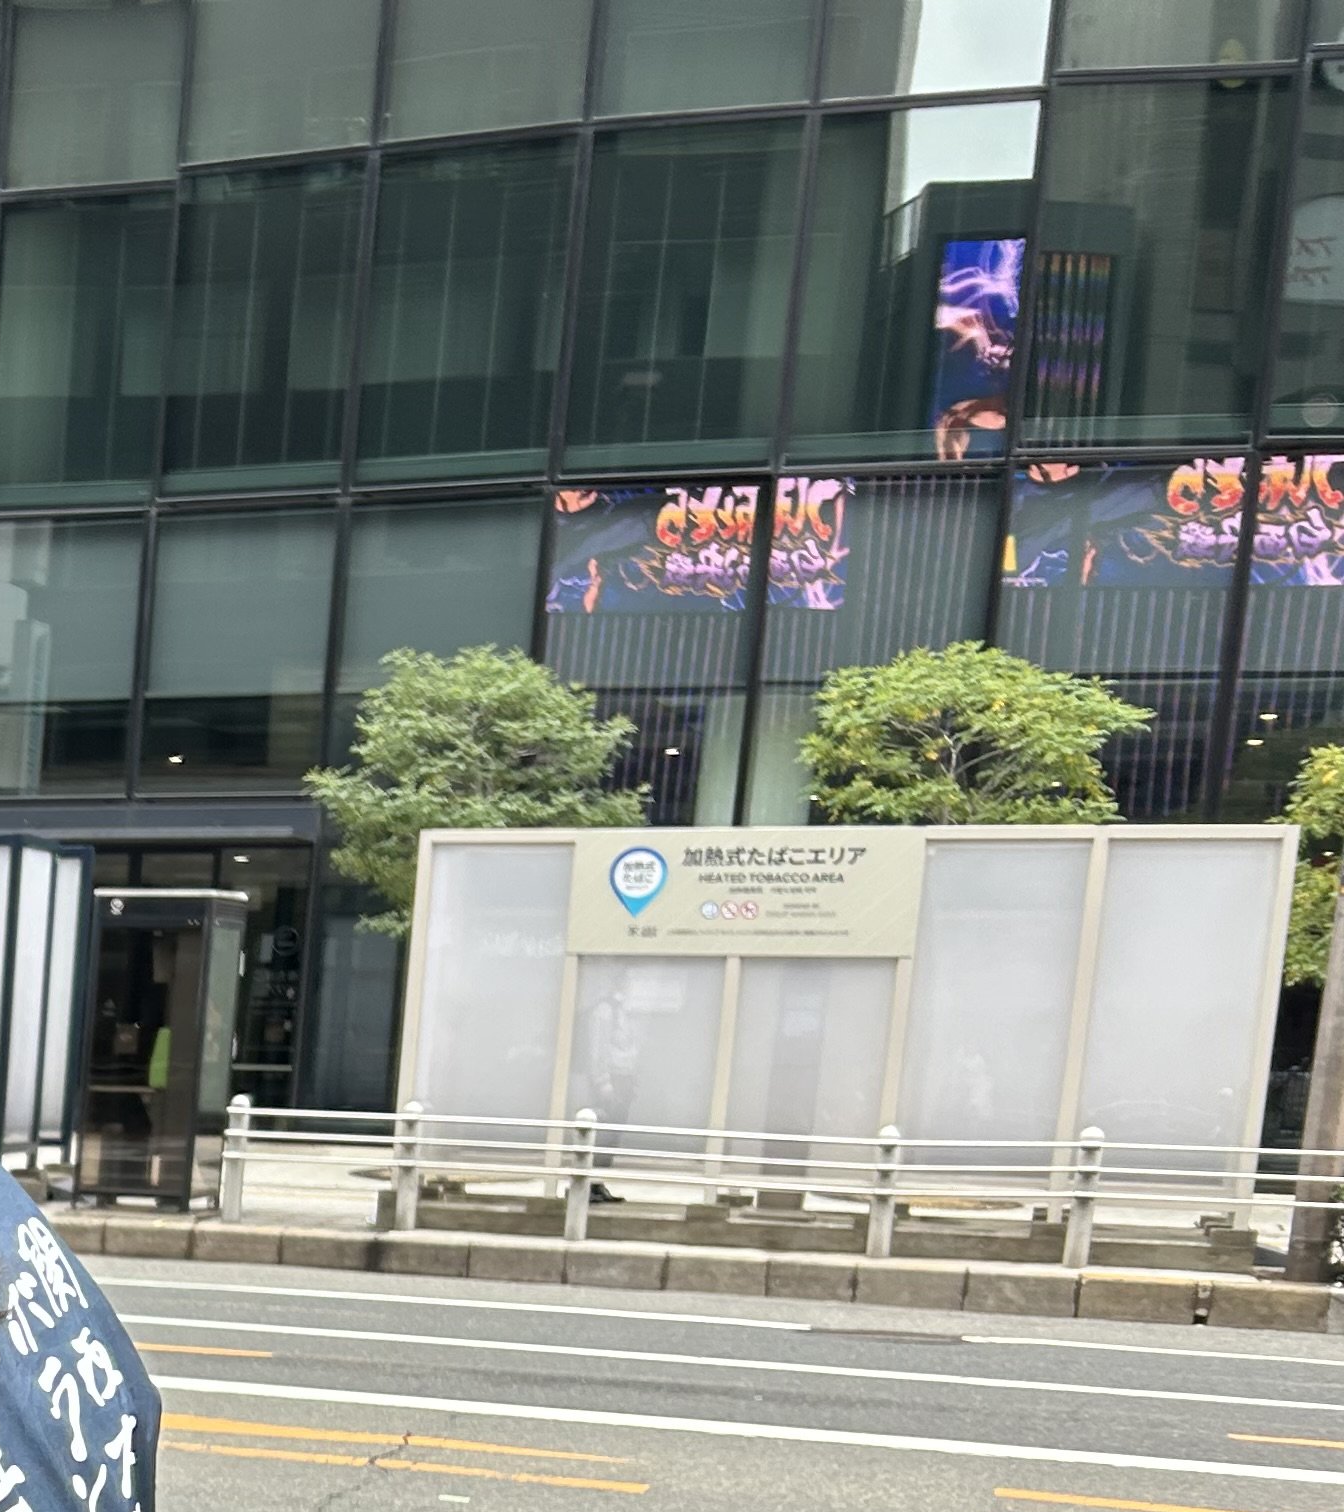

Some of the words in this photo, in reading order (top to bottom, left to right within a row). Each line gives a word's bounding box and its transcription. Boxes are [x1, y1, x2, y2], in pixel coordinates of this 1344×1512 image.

[682, 846, 867, 866] 加熱式たばこエリア
[623, 861, 656, 872] 加熱式
[623, 872, 654, 884] たばこ
[698, 872, 746, 883] HEATED
[750, 872, 810, 883] TOBACCO
[813, 872, 845, 883] AREA
